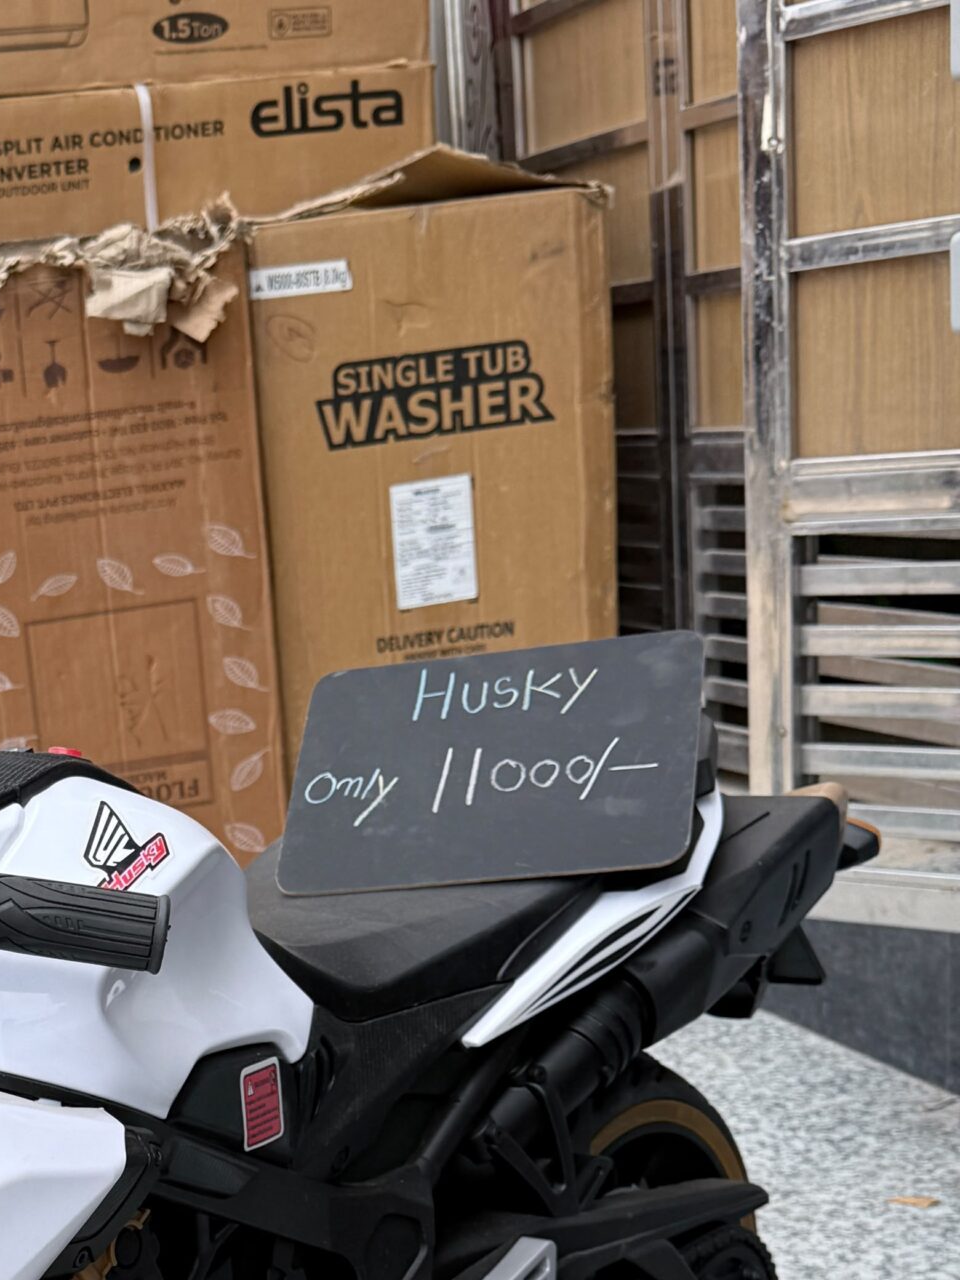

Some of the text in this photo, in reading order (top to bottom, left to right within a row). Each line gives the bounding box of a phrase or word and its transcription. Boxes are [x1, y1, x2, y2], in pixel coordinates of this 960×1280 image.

[250, 79, 405, 139] elista
[50, 134, 83, 152] AIR
[89, 120, 225, 148] CONDTIONER
[60, 179, 91, 193] UNIT
[336, 345, 528, 397] SINGLE TUB
[321, 376, 545, 447] WASHER
[376, 620, 515, 653] DELIVERY CAUTION
[411, 667, 599, 722] HUSKY
[140, 778, 199, 802] FLOU
[431, 736, 660, 814] 11000/-
